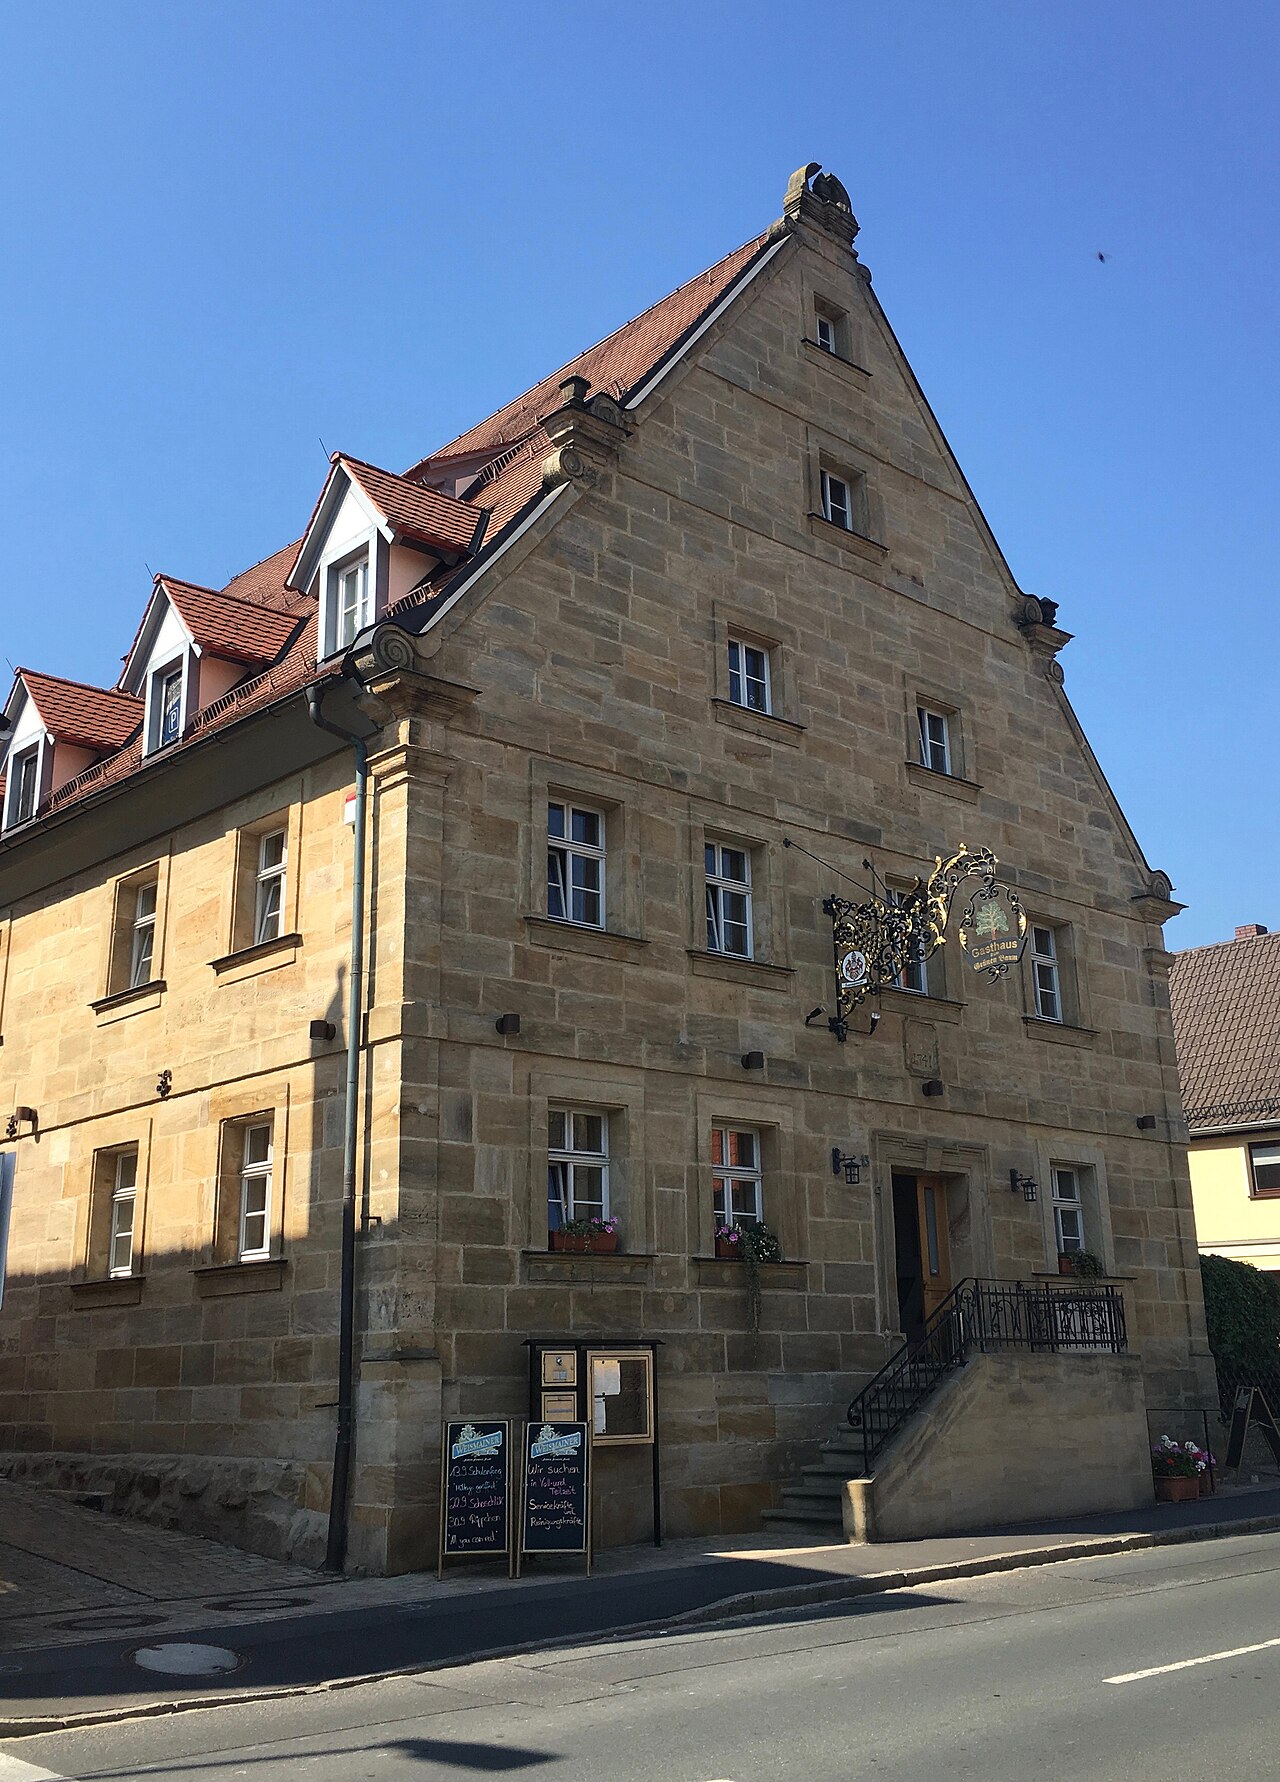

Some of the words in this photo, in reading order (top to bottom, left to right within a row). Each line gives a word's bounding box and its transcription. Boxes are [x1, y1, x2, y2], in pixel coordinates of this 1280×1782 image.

[972, 940, 1018, 957] Gasthaus
[456, 1437, 500, 1454] WEISMAINER
[535, 1437, 578, 1454] WEISMAINER
[528, 1464, 543, 1475] Wir
[547, 1463, 580, 1474] suchen
[531, 1479, 536, 1487] in
[549, 1485, 576, 1495] Teilzeit
[529, 1499, 573, 1510] Servicekräfte
[531, 1516, 583, 1530] Reinigungskräfte
